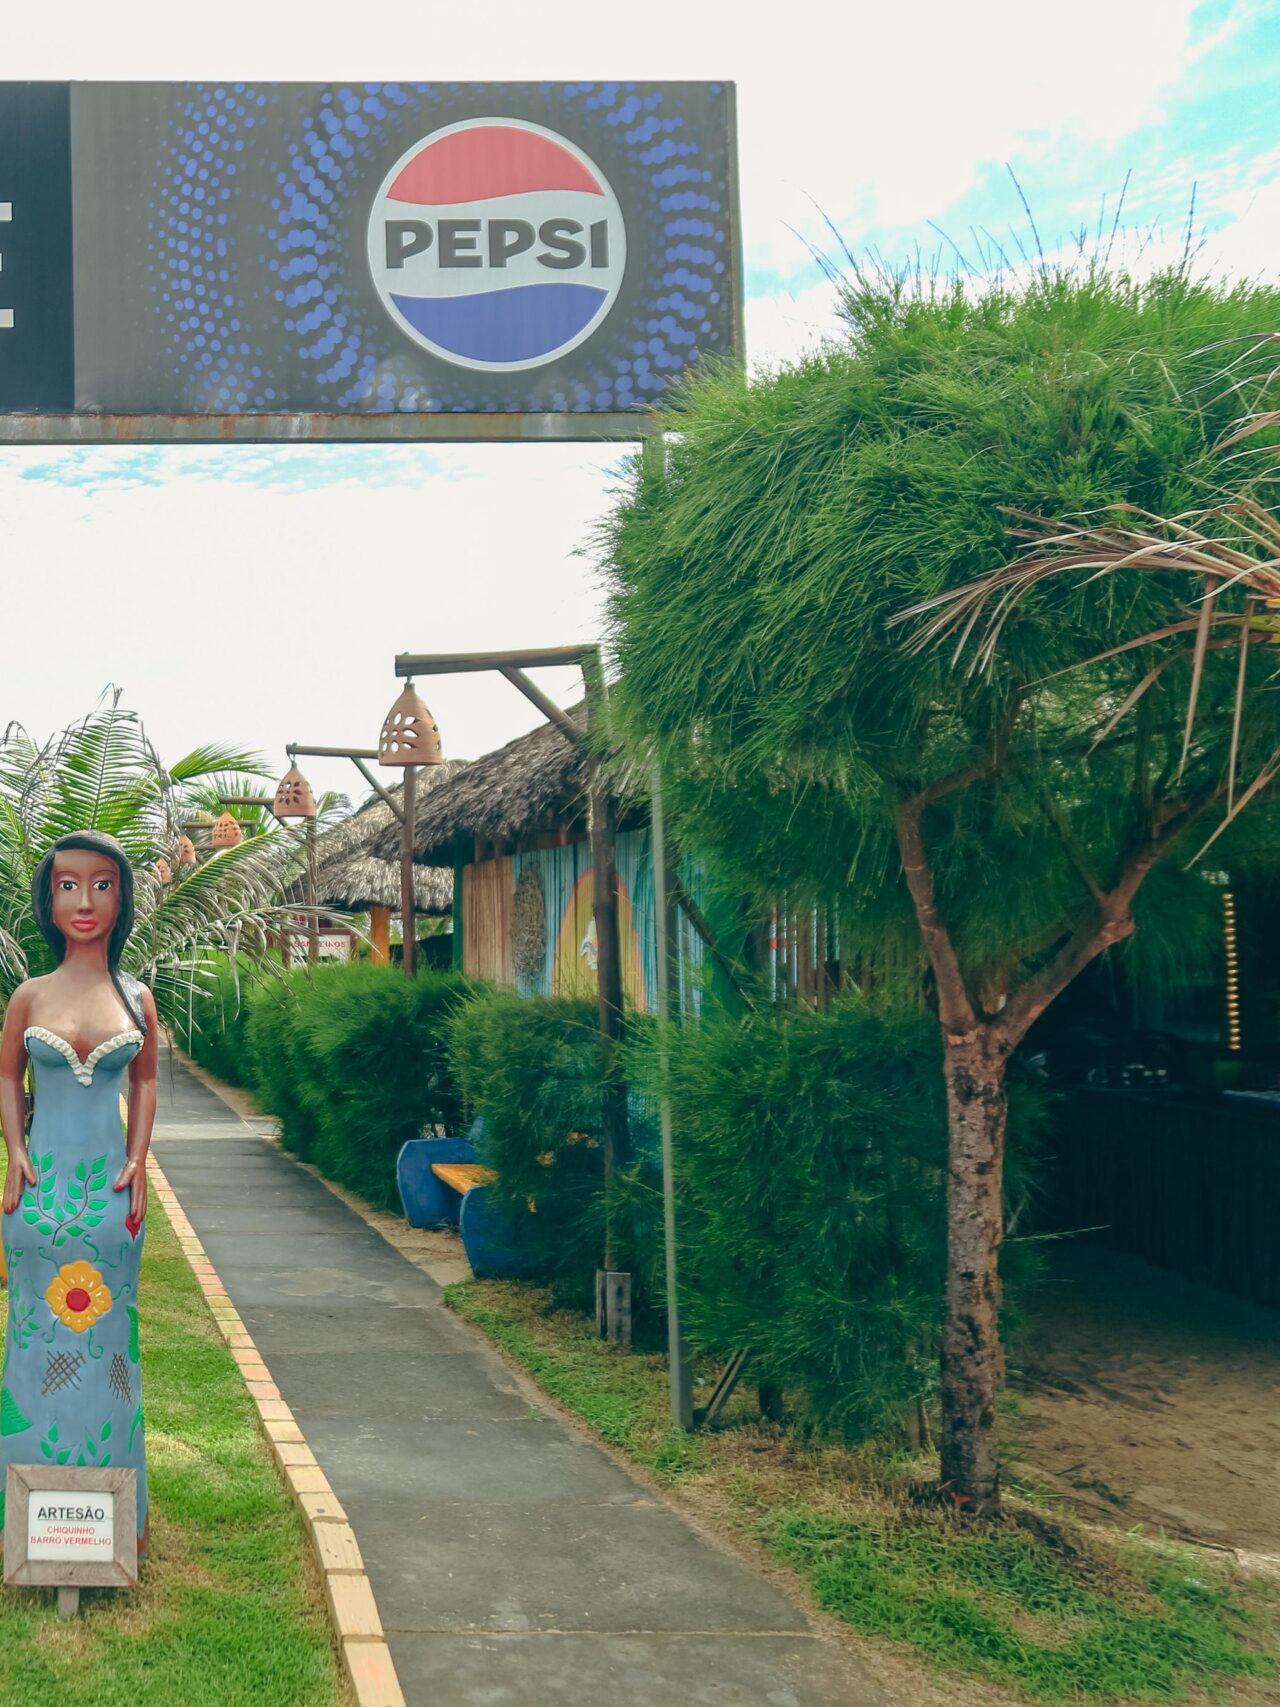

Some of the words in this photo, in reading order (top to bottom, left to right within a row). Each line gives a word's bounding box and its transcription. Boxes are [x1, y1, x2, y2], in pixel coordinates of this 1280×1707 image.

[384, 218, 610, 270] PEPSI
[37, 1505, 105, 1520] ARTESÃO
[47, 1526, 96, 1535] CHIQUINHO
[30, 1535, 62, 1545] BARRO
[64, 1537, 112, 1546] VERMELHO
